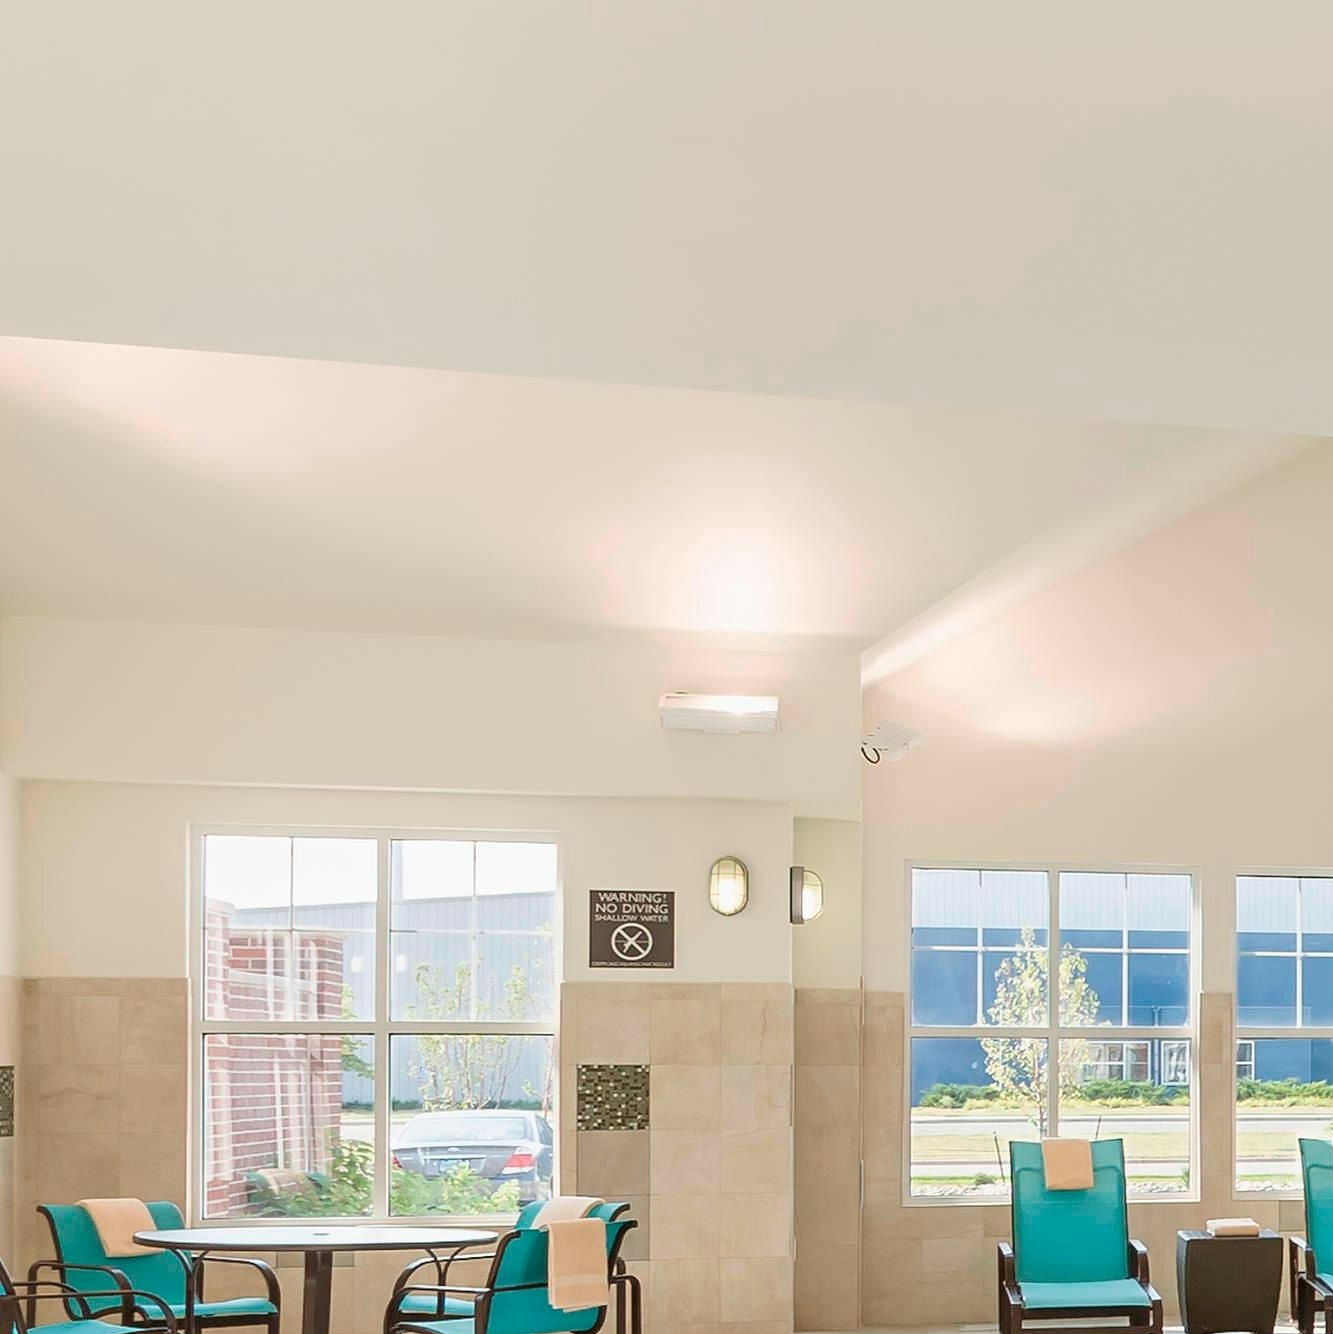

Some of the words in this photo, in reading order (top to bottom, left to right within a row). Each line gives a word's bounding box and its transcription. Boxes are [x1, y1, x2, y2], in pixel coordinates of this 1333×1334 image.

[598, 892, 667, 904] WARNING!
[595, 903, 618, 913] NO
[622, 903, 669, 914] DIVING
[595, 914, 638, 922] SHALLOW
